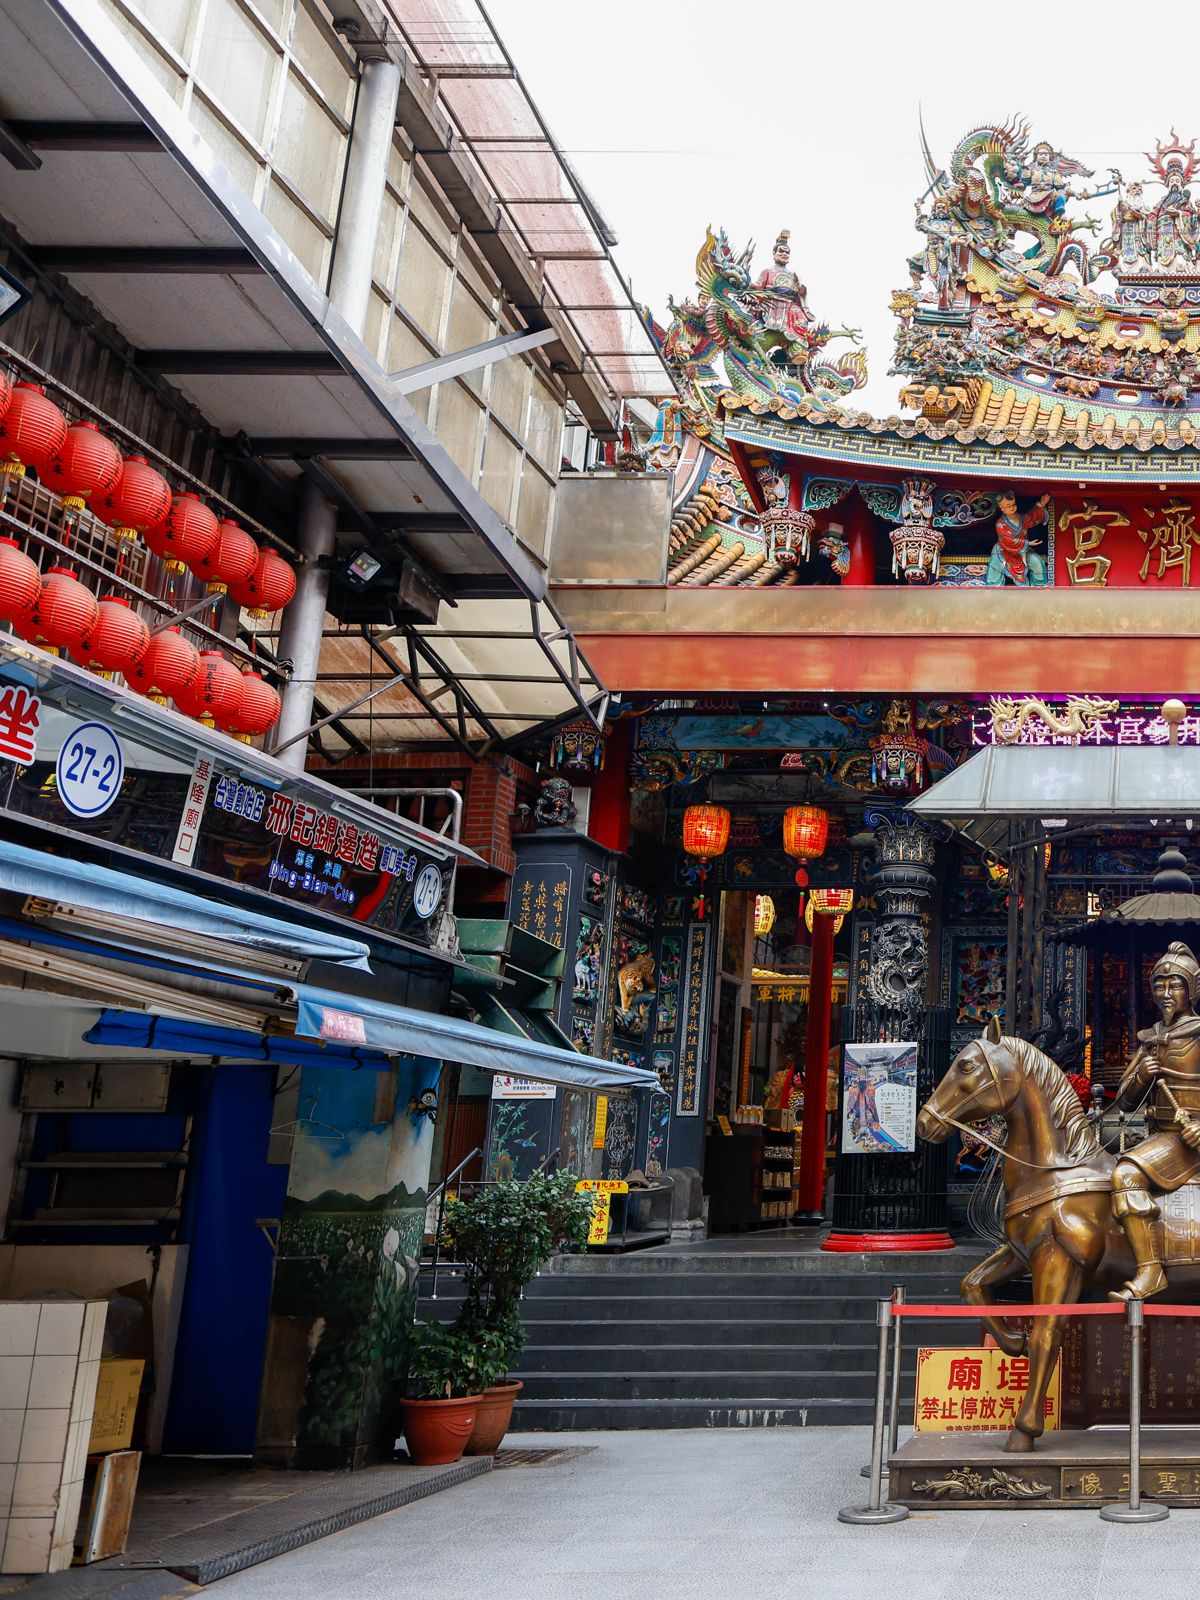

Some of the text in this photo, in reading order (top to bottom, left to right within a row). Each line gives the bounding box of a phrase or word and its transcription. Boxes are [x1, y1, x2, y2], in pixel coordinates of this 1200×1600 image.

[65, 742, 115, 793] 27-2
[178, 759, 211, 853] 基隆廟口
[269, 860, 355, 904] Ding-Bian-Cuo
[948, 1357, 1030, 1391] 廟埕
